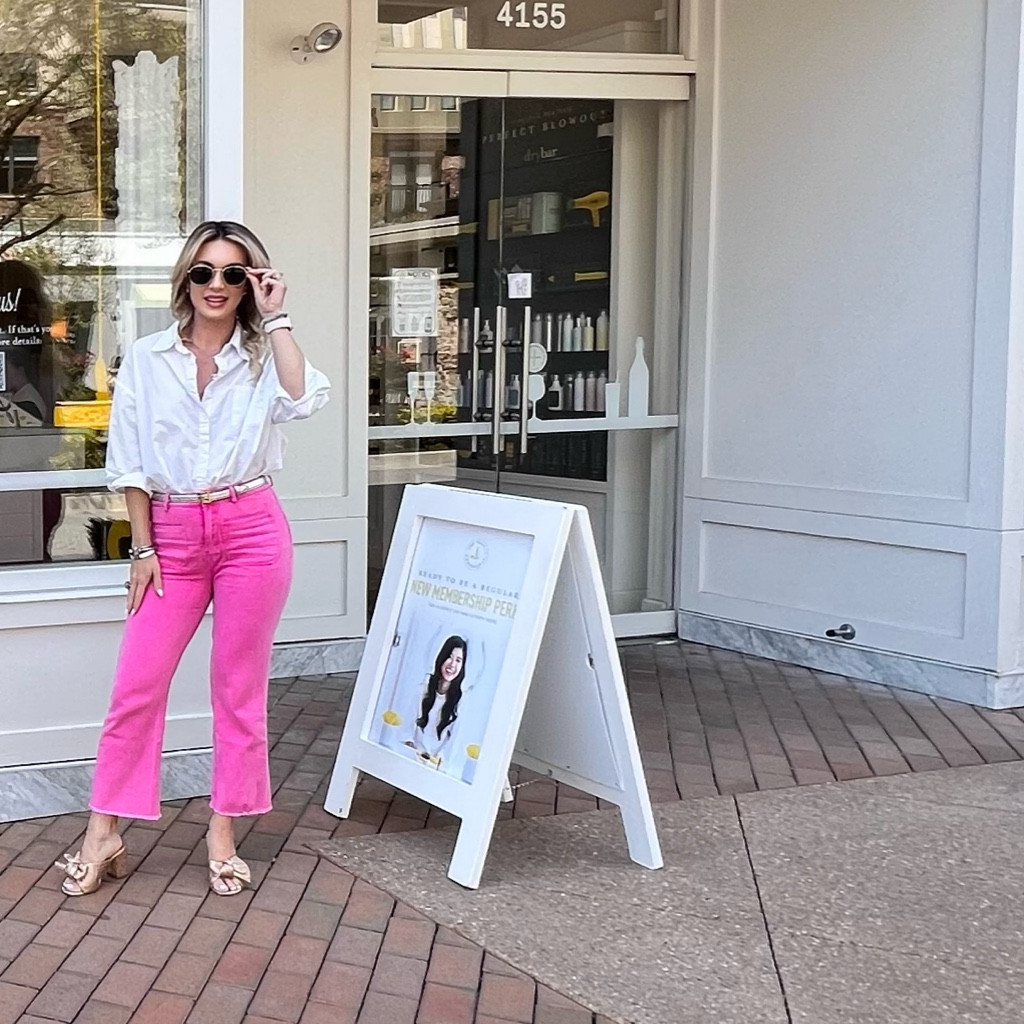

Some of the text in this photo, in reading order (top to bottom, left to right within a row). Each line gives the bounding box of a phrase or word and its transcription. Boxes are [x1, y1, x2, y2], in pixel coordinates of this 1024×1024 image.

[496, 1, 566, 29] 4155
[8, 325, 16, 334] If
[17, 324, 40, 334] that's
[418, 570, 443, 581] READY
[446, 575, 456, 584] TO
[410, 579, 433, 597] NEW
[431, 584, 493, 612] MEMBERSHIP
